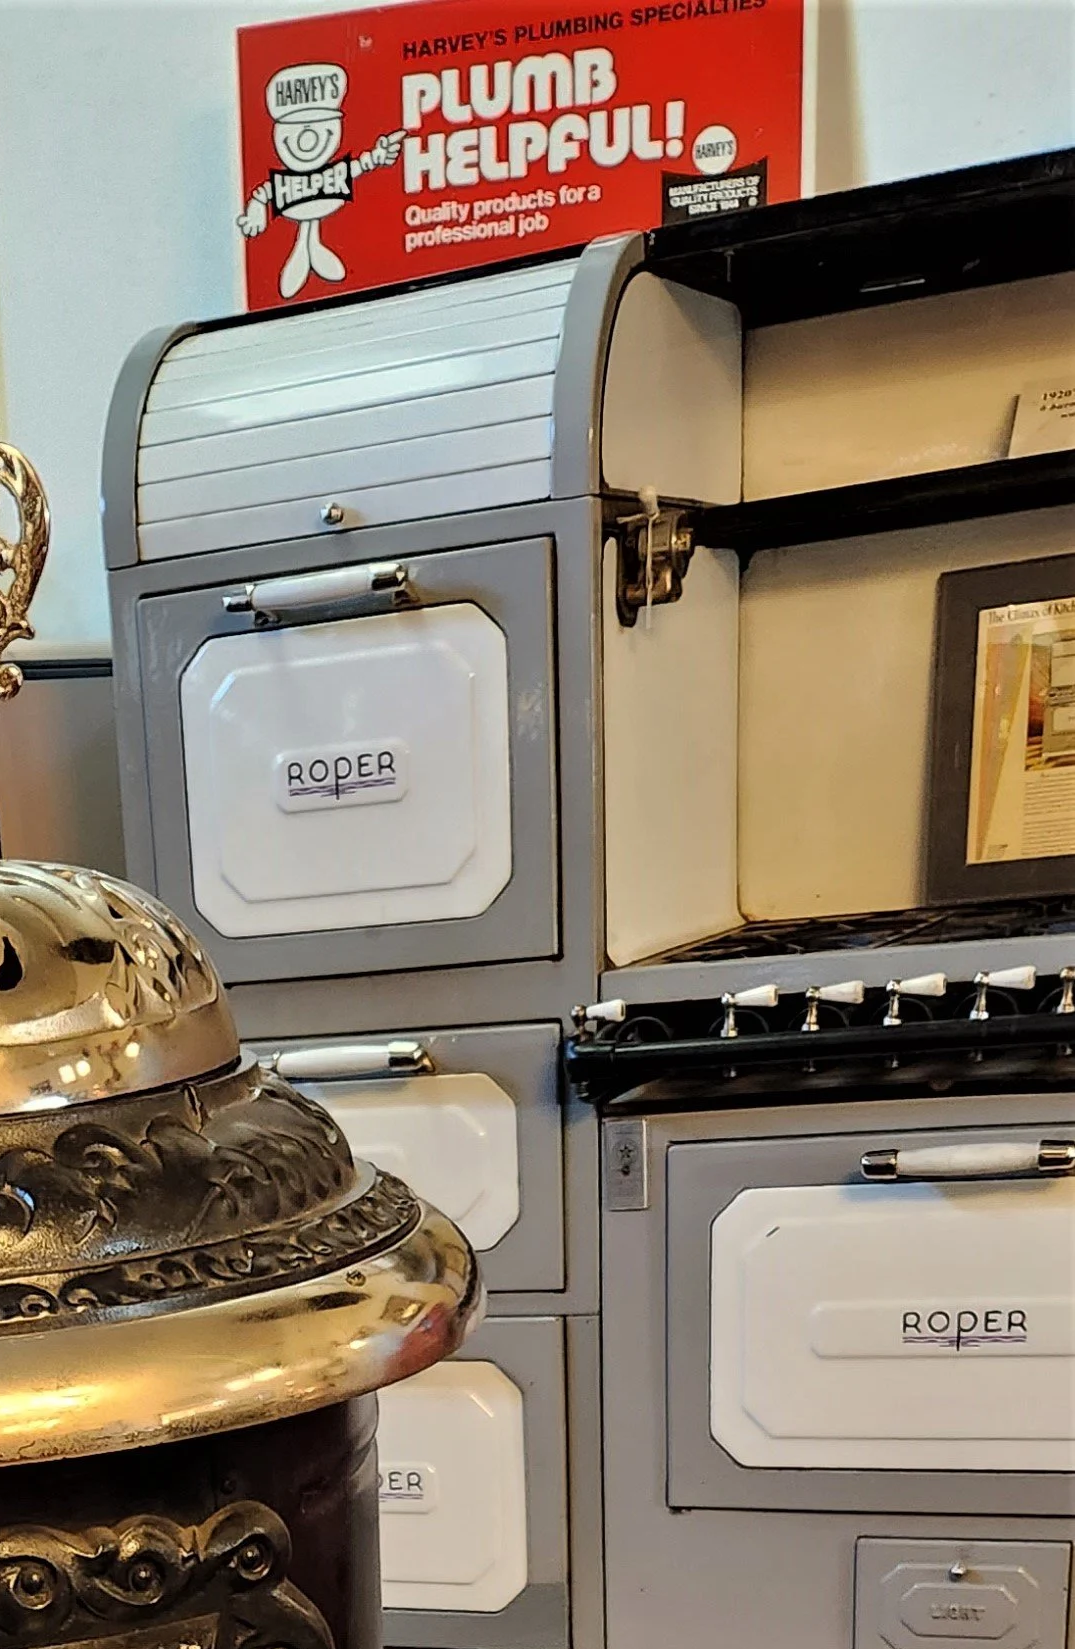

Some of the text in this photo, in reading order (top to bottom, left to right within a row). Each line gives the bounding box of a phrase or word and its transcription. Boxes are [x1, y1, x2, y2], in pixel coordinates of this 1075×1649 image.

[403, 28, 507, 60] HARVEY'S
[514, 15, 624, 44] PLUMBING
[275, 73, 340, 107] HARVEY'S
[402, 46, 618, 130] PLUMB
[403, 100, 685, 194] HELPFUL!
[274, 161, 351, 210] HELPER
[405, 184, 601, 227] Quality products for a
[709, 186, 759, 203] PRODUCTS
[405, 212, 549, 253] professional job
[288, 751, 396, 801] ROPER
[902, 1310, 1028, 1352] ROPER
